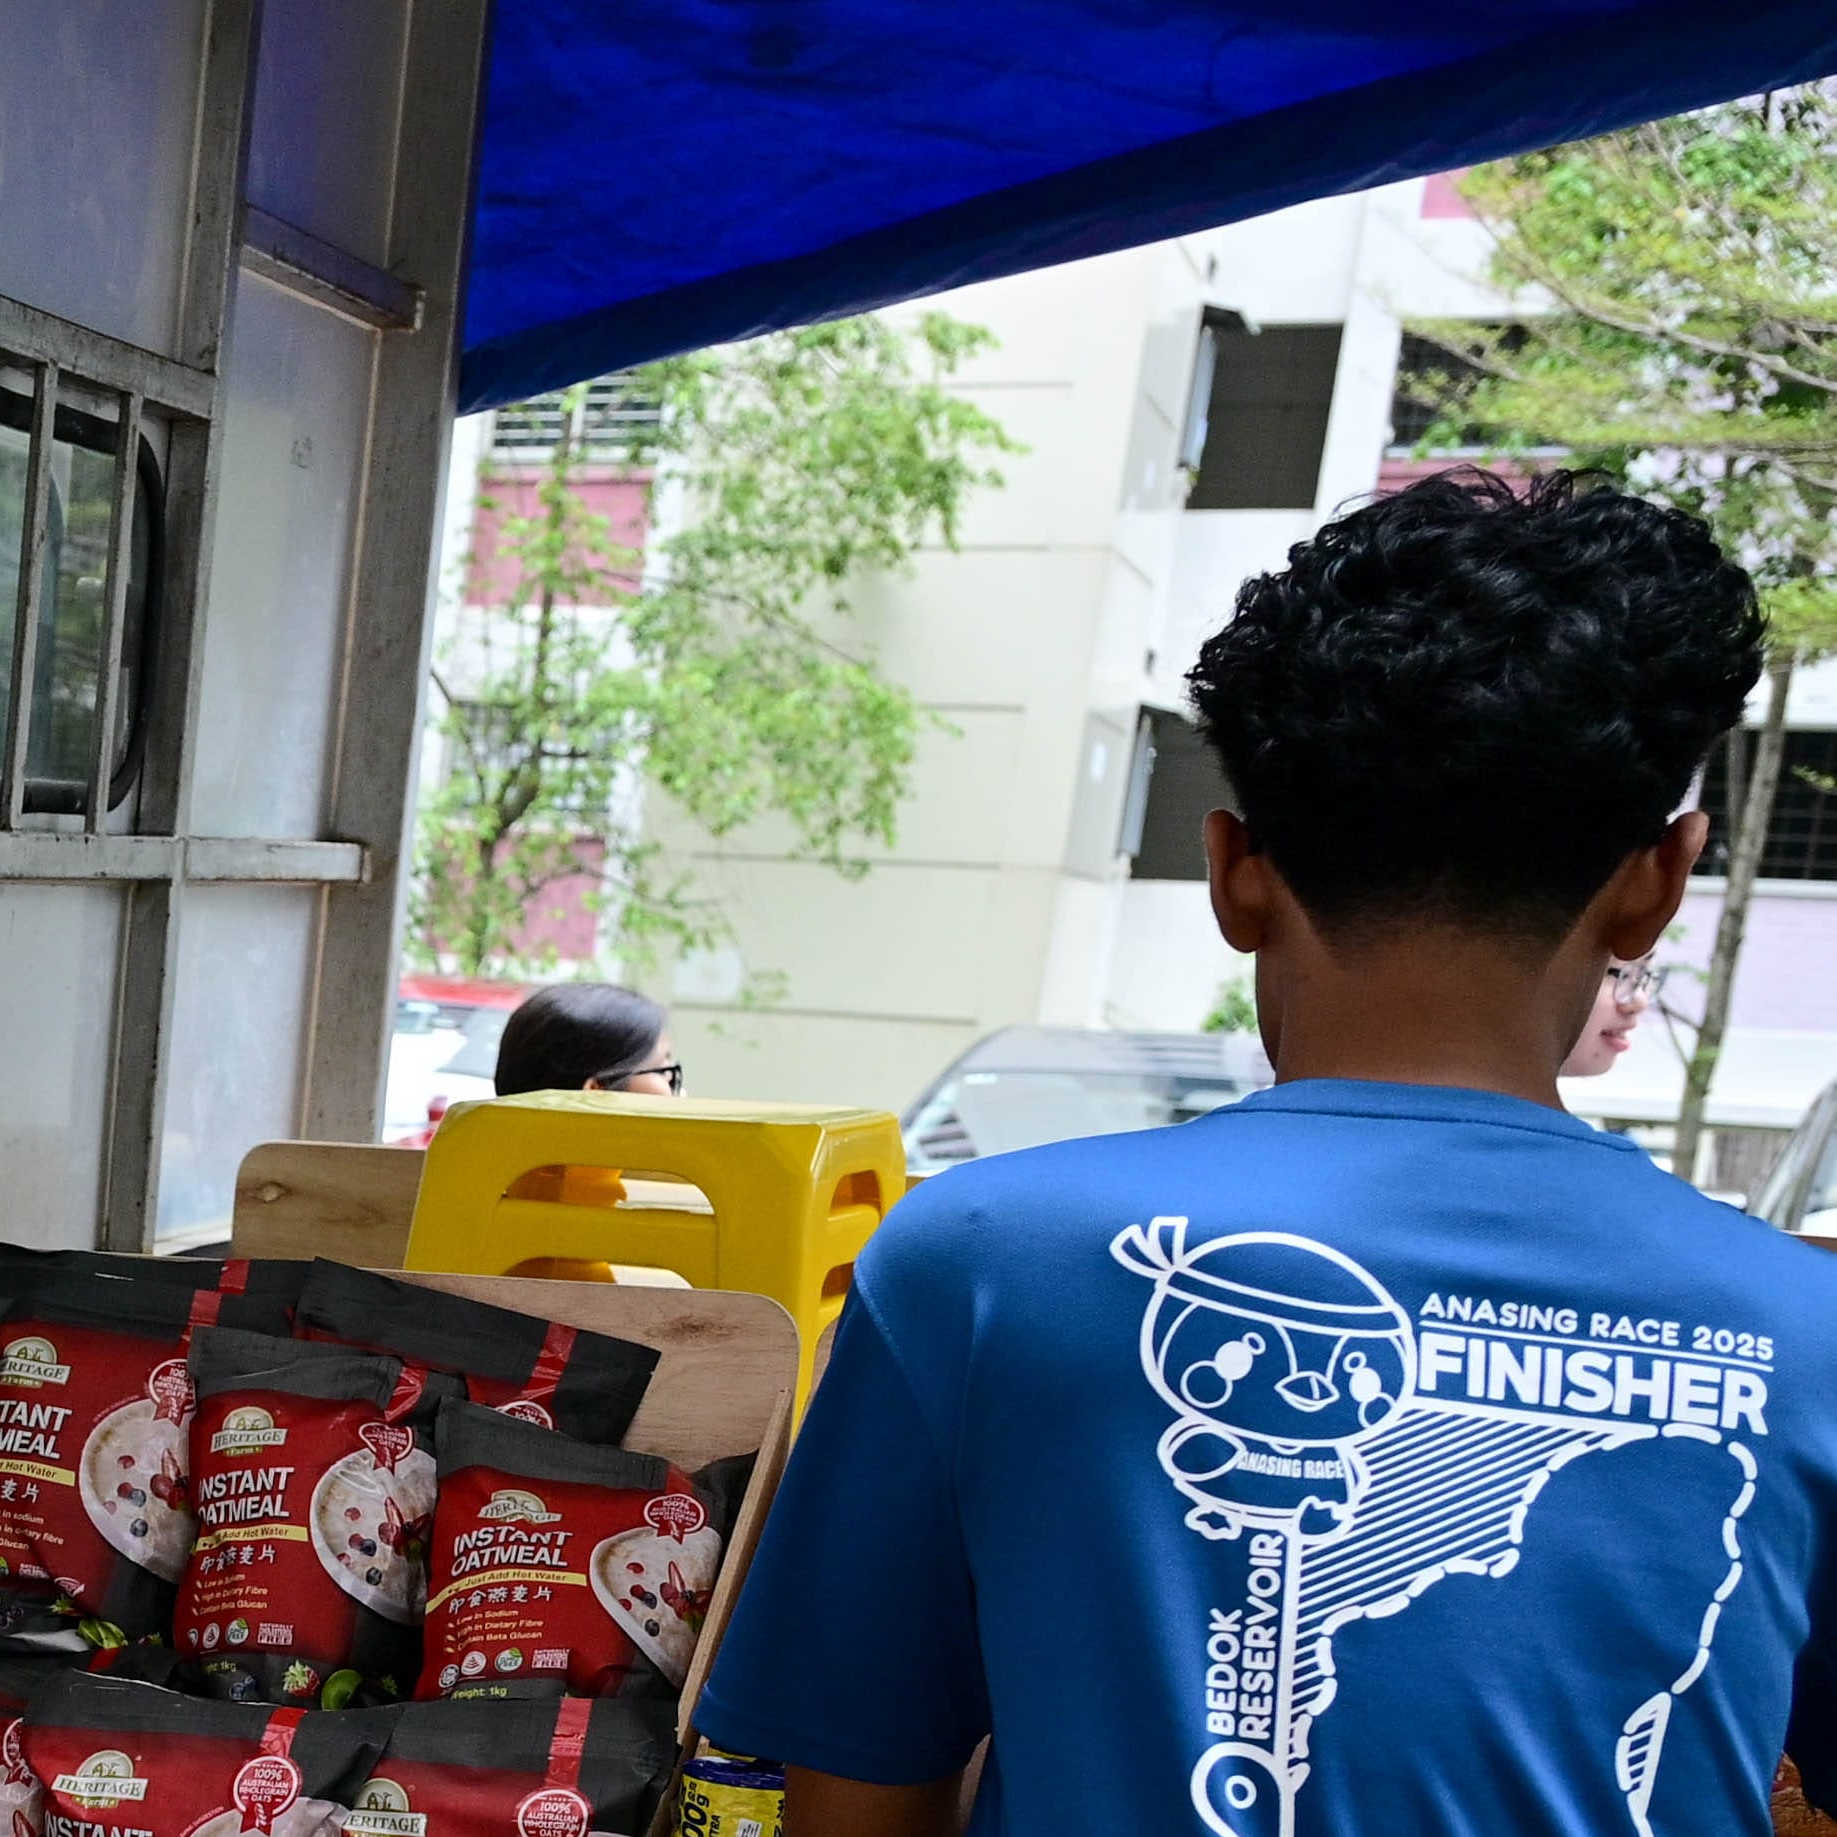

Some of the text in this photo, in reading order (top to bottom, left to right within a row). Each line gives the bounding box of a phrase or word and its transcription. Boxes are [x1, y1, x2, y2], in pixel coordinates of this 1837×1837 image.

[1420, 1292, 1774, 1361] ANASING RACE 2025
[1418, 1331, 1769, 1436] FINISHER
[213, 1430, 282, 1449] HERITAGE
[5, 1462, 23, 1472] Hot
[25, 1465, 58, 1480] Water
[1237, 1450, 1345, 1479] ANASING RACE
[2, 1509, 12, 1519] in
[13, 1512, 45, 1525] sodium
[4, 1525, 13, 1534] in
[43, 1532, 65, 1545] fibre
[243, 1527, 259, 1538] Hot
[260, 1525, 289, 1536] Water
[454, 1526, 574, 1556] INSTANT
[451, 1546, 569, 1577] OATMEAL
[465, 1570, 567, 1588] Just Add Hot Water
[245, 1585, 269, 1596] Fibre
[237, 1599, 268, 1609] Glucan
[484, 1609, 519, 1619] Sodium
[484, 1619, 518, 1631] Dietary
[519, 1619, 544, 1628] Fibre
[486, 1632, 508, 1642] Beta
[509, 1631, 543, 1640] Glucan
[1238, 1533, 1285, 1740] RESERVOIR
[1206, 1607, 1243, 1737] BEDOK
[452, 1686, 508, 1700] eight: 1kg
[254, 1768, 283, 1781] 100%
[57, 1779, 143, 1797] HERITAGE
[239, 1786, 289, 1797] WHOLEGRAIN
[242, 1779, 289, 1789] AUSTRALIAN
[250, 1794, 272, 1804] OATS
[539, 1801, 572, 1814] 100%
[349, 1813, 421, 1834] ERITAGE
[526, 1811, 580, 1823] AUSTRALIAN
[524, 1819, 580, 1832] WHOLEGRAIN
